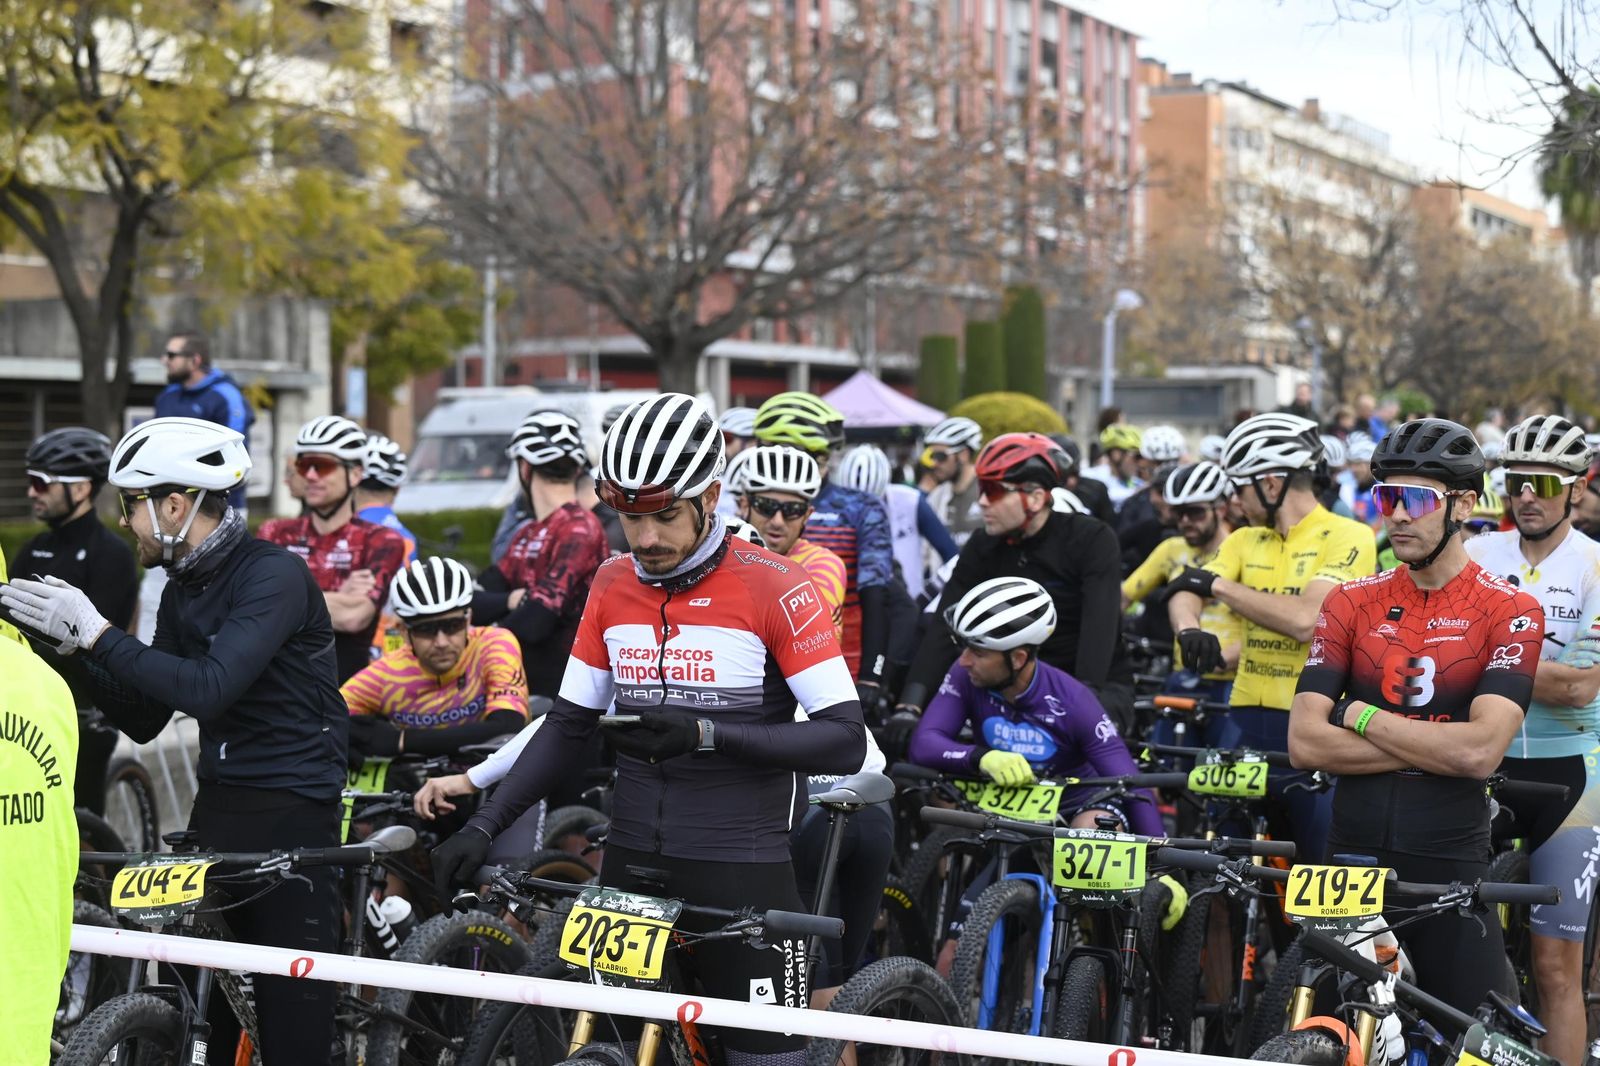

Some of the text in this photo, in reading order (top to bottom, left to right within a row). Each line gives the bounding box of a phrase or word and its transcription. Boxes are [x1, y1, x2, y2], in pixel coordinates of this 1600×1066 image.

[745, 553, 790, 574] ESCAYESCOS
[789, 590, 814, 612] PYL
[793, 631, 832, 654] Peñalver
[619, 647, 713, 663] escayescos
[1196, 765, 1262, 791] 306-2
[987, 787, 1056, 814] 327-2
[1060, 843, 1137, 880] 327-1
[119, 865, 203, 899] 204-2
[1294, 868, 1381, 906] 219-2
[151, 897, 166, 905] VILA
[466, 925, 513, 945] MAXXIS
[569, 912, 661, 969] 203-1
[593, 961, 628, 974] CALABRUS
